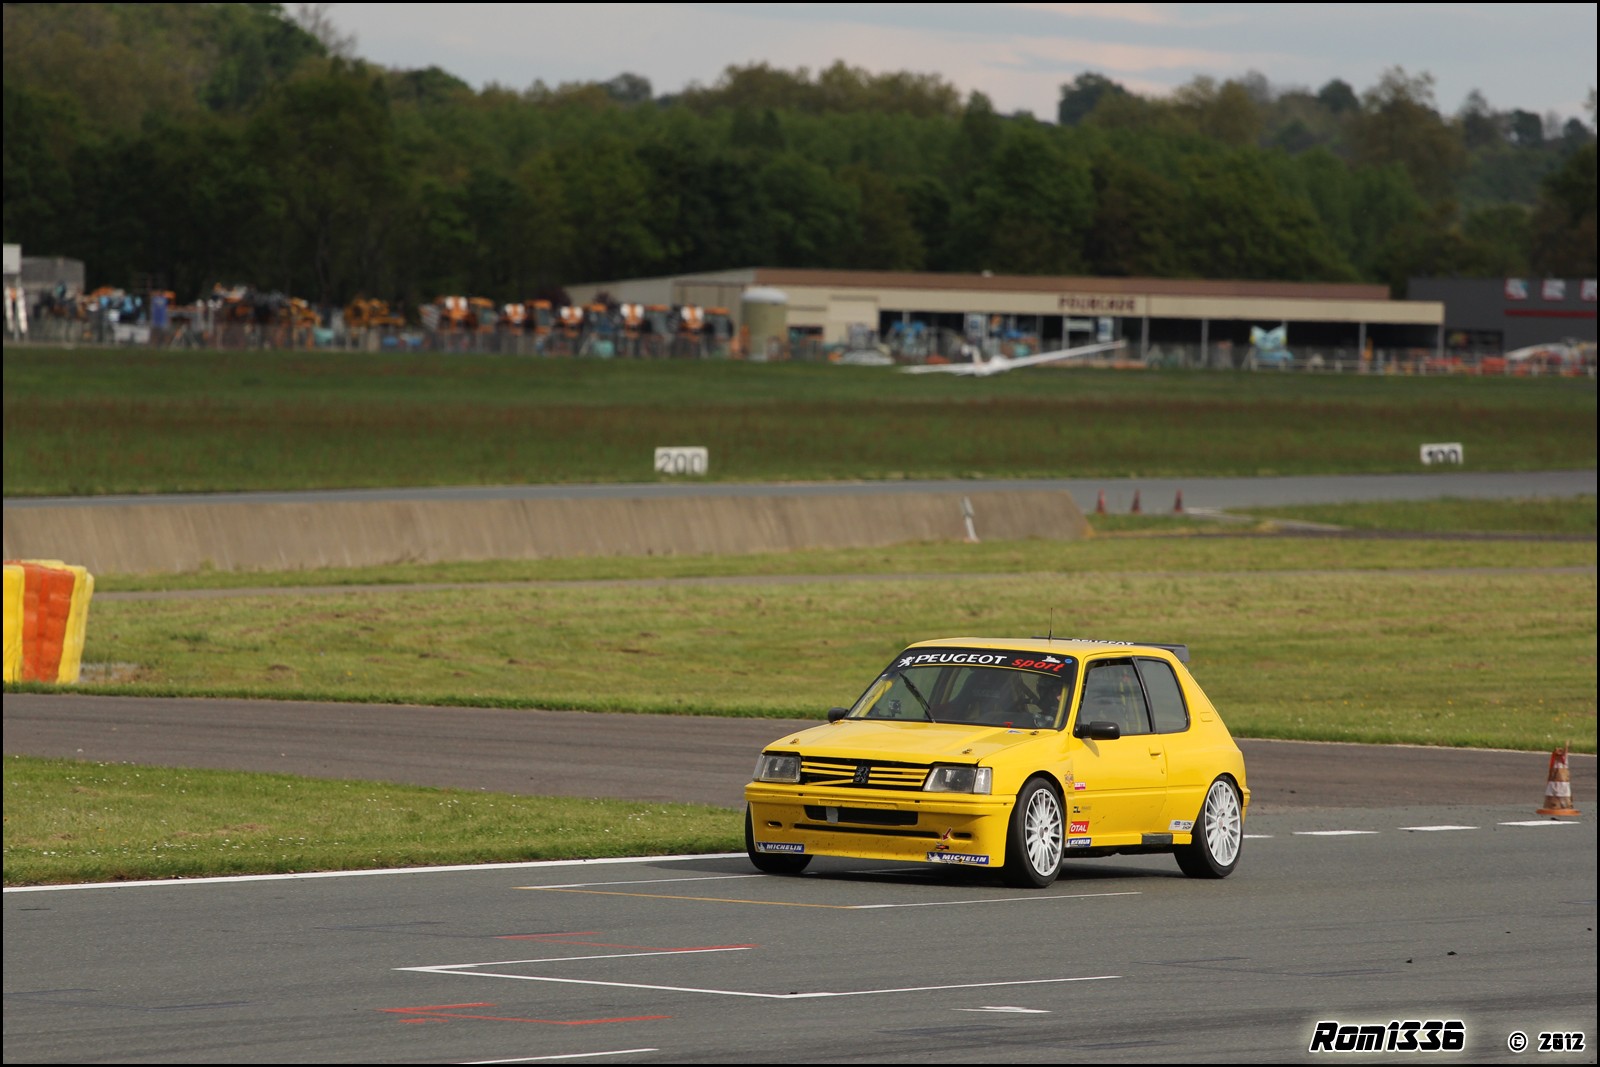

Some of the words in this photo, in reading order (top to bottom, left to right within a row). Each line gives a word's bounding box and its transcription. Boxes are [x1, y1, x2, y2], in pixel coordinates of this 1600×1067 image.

[659, 452, 704, 474] 200
[914, 653, 1008, 665] PEUGEOT
[1011, 657, 1065, 672] sport
[1070, 823, 1087, 832] OTAL
[766, 843, 803, 851] MICHELIN
[941, 854, 987, 863] MICHELIN
